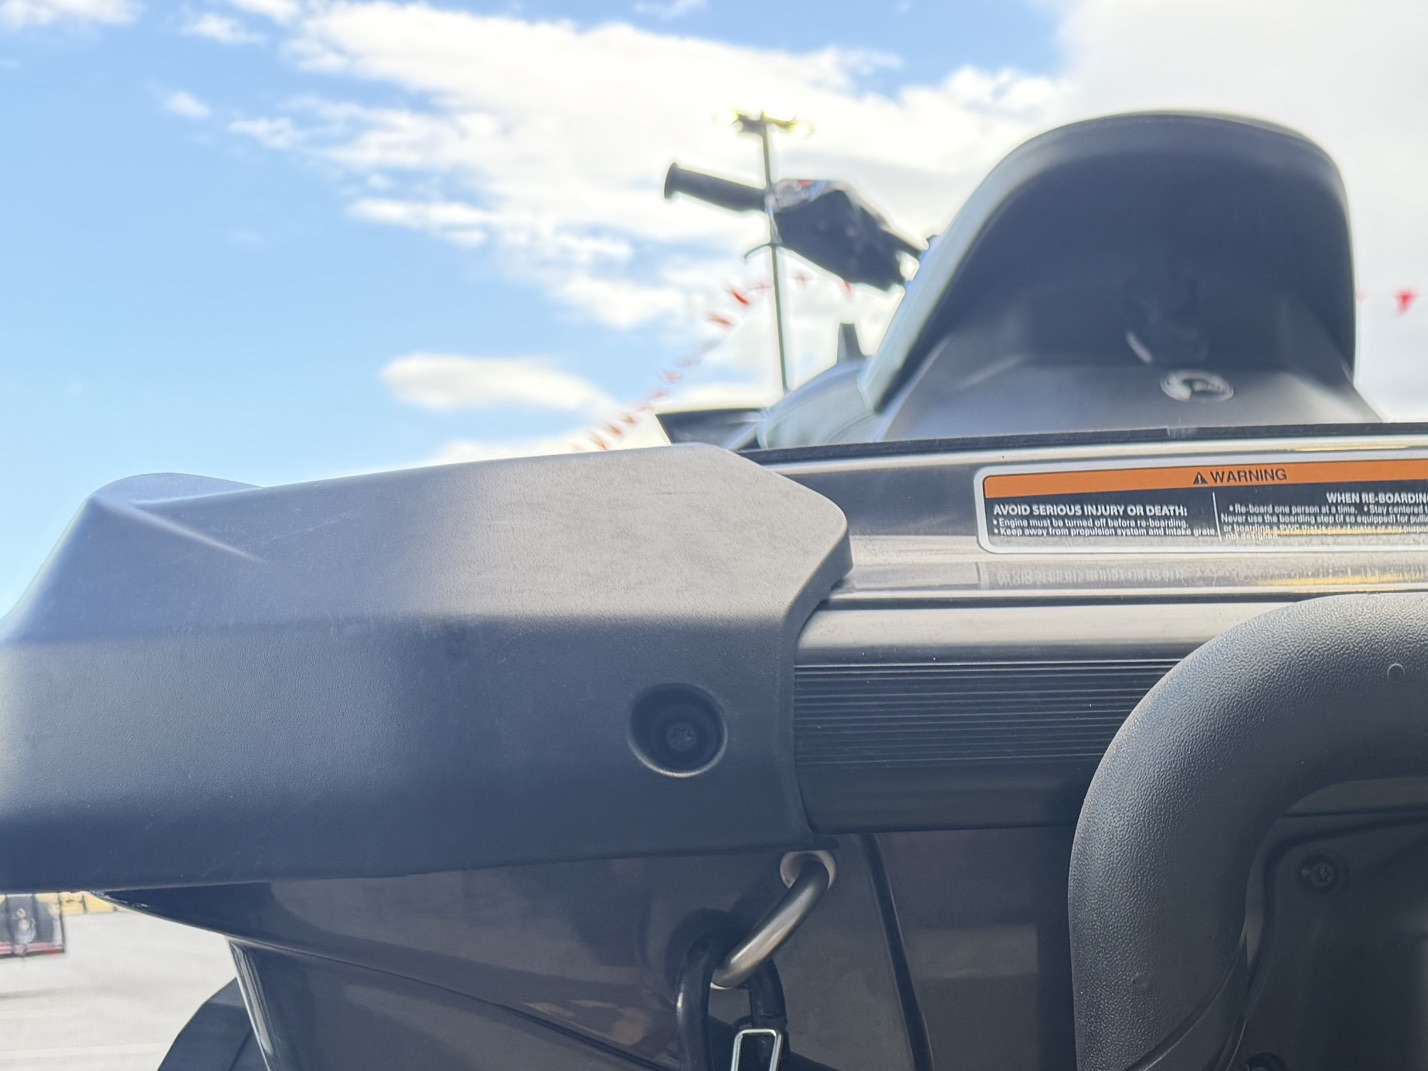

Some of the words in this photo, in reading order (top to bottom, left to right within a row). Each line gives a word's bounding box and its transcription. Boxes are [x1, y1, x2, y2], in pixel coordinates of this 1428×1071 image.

[1211, 468, 1287, 484] WARNING
[1326, 492, 1360, 504] WHEN
[993, 504, 1031, 517] AVOID
[1033, 504, 1082, 517] SERIOUS
[1084, 504, 1126, 517] INJURY
[1128, 504, 1144, 517] OR
[1146, 504, 1188, 517] DEATH:
[1234, 503, 1273, 514] Re-board
[1274, 505, 1290, 514] one
[1291, 505, 1320, 516] person
[1321, 504, 1330, 514] at
[1331, 505, 1336, 513] a
[1337, 504, 1358, 514] time.
[1369, 504, 1387, 515] Stay
[1388, 504, 1424, 514] centered
[999, 518, 1028, 530] Engine
[1029, 517, 1050, 527] must
[1051, 517, 1062, 527] be
[1063, 517, 1093, 527] turned
[1094, 517, 1106, 527] off
[1107, 517, 1135, 527] before
[1137, 517, 1189, 529] re-boarding.
[1220, 512, 1246, 523] Never
[1247, 514, 1263, 523] use
[1264, 513, 1278, 523] the
[1279, 513, 1315, 525] boarding
[1317, 513, 1334, 525] step
[1345, 515, 1355, 523] so
[1397, 513, 1408, 523] for
[1000, 527, 1023, 538] Keep
[1024, 528, 1048, 537] away
[1049, 527, 1069, 536] from
[1070, 527, 1116, 537] propulsion
[1117, 527, 1147, 537] system
[1148, 526, 1164, 536] and
[1165, 526, 1192, 536] intake
[1223, 524, 1233, 532] or
